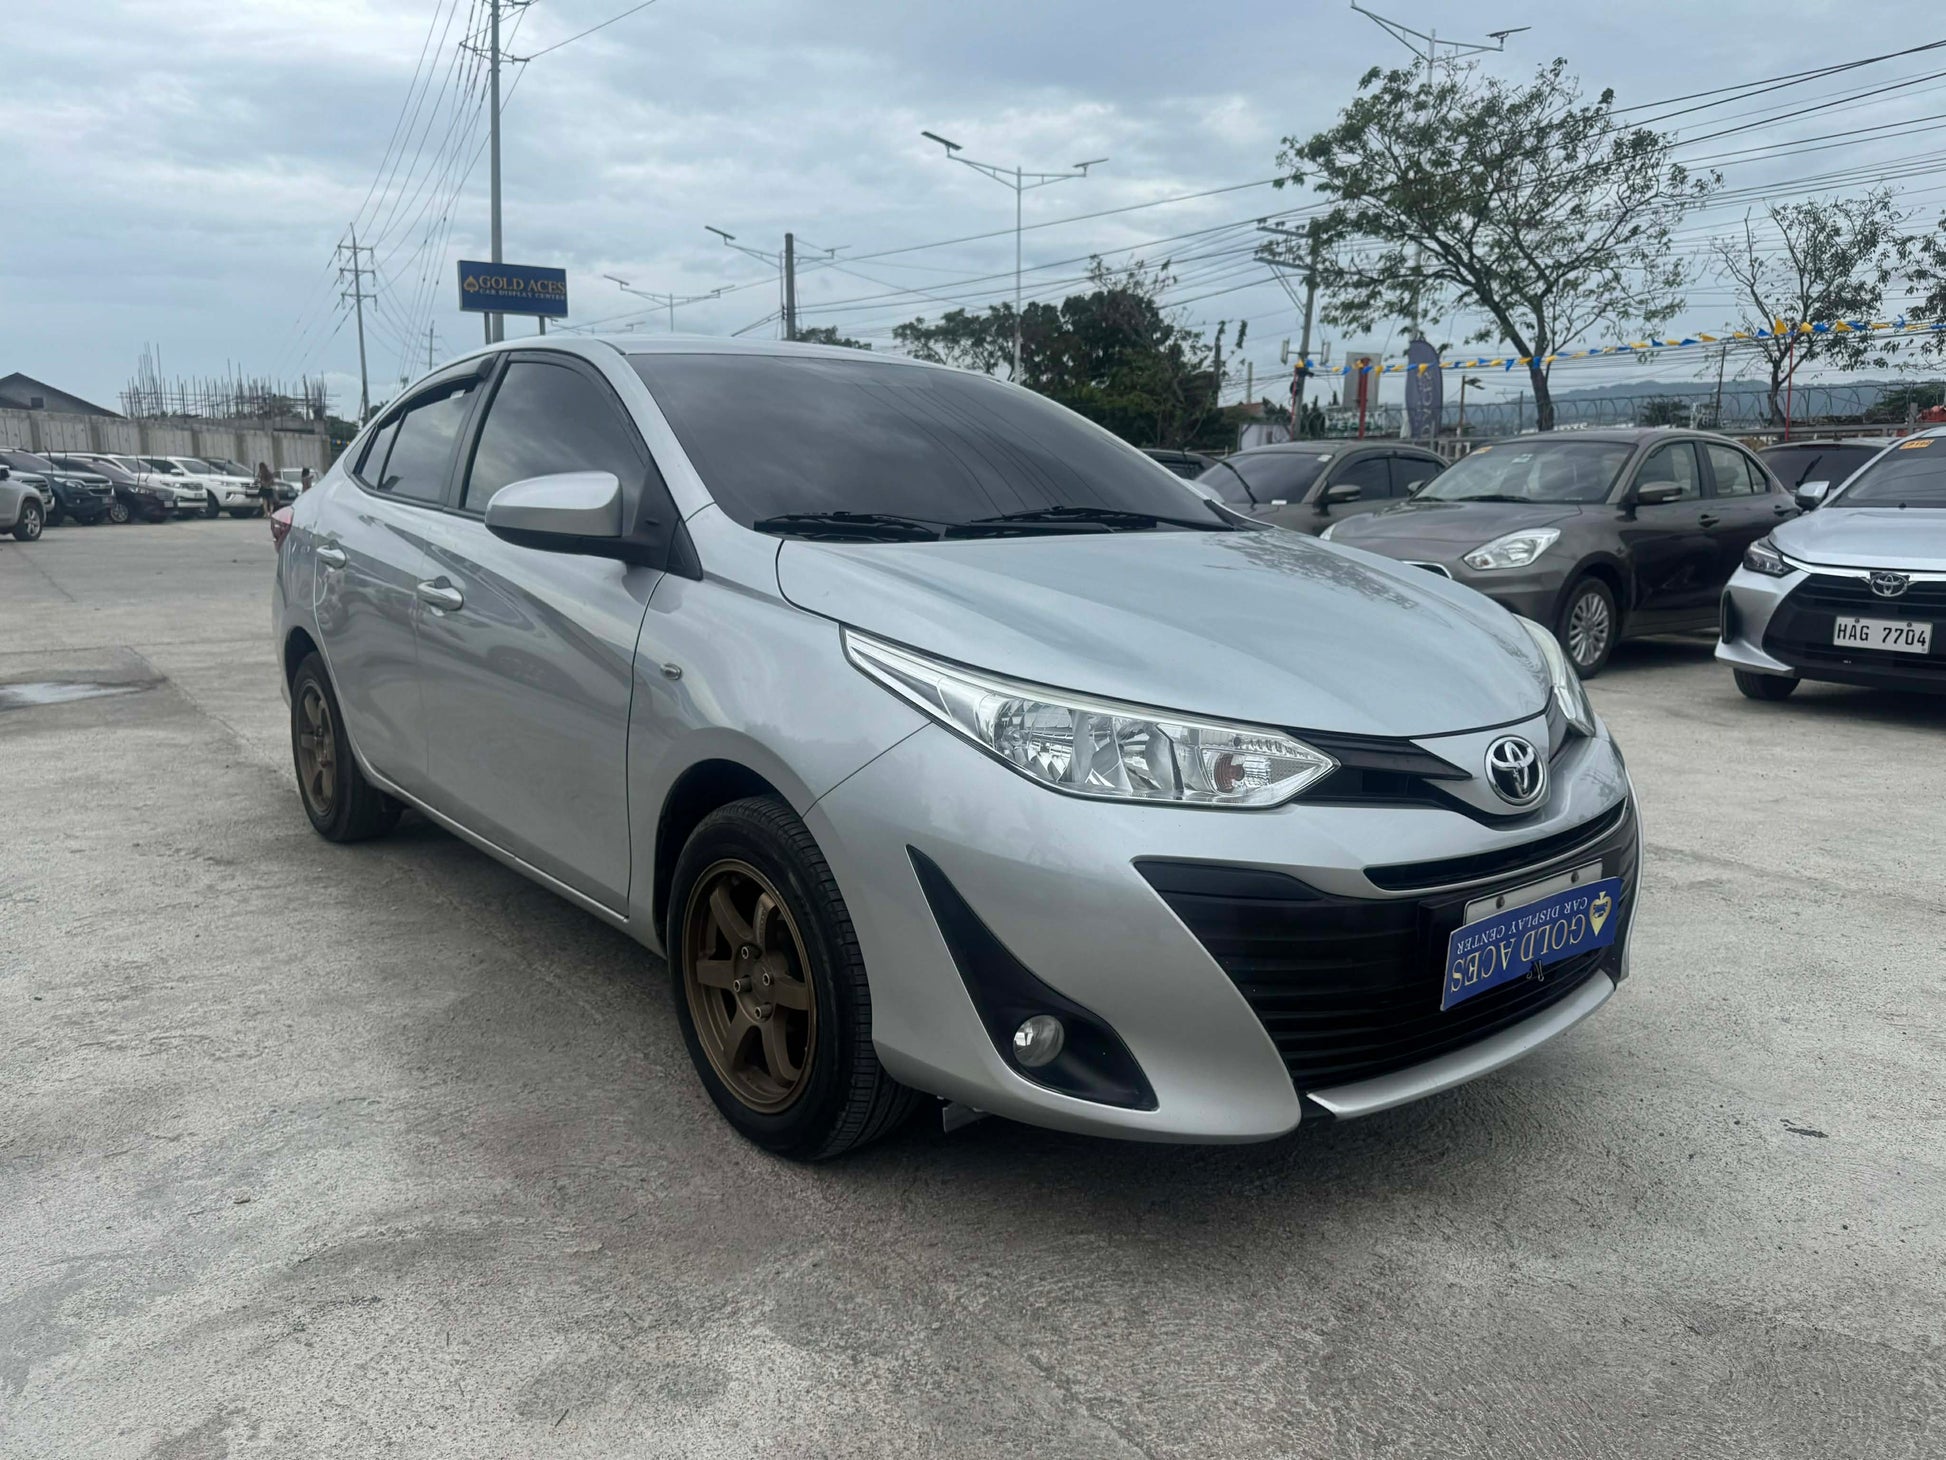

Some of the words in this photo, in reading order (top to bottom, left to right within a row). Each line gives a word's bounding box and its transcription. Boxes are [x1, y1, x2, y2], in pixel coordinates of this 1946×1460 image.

[479, 275, 525, 290] GOLD
[527, 279, 566, 294] ACES
[479, 288, 498, 296] CAR
[499, 290, 532, 298] DISPLAY
[535, 292, 565, 300] CENTER
[1837, 623, 1870, 642] HAG
[1882, 627, 1927, 647] 7704
[1563, 897, 1588, 914] CAR
[1508, 904, 1559, 934] DISPLAY
[1457, 925, 1506, 954] CENTER
[1520, 914, 1586, 962] GOLD
[1450, 937, 1517, 993] ACES
